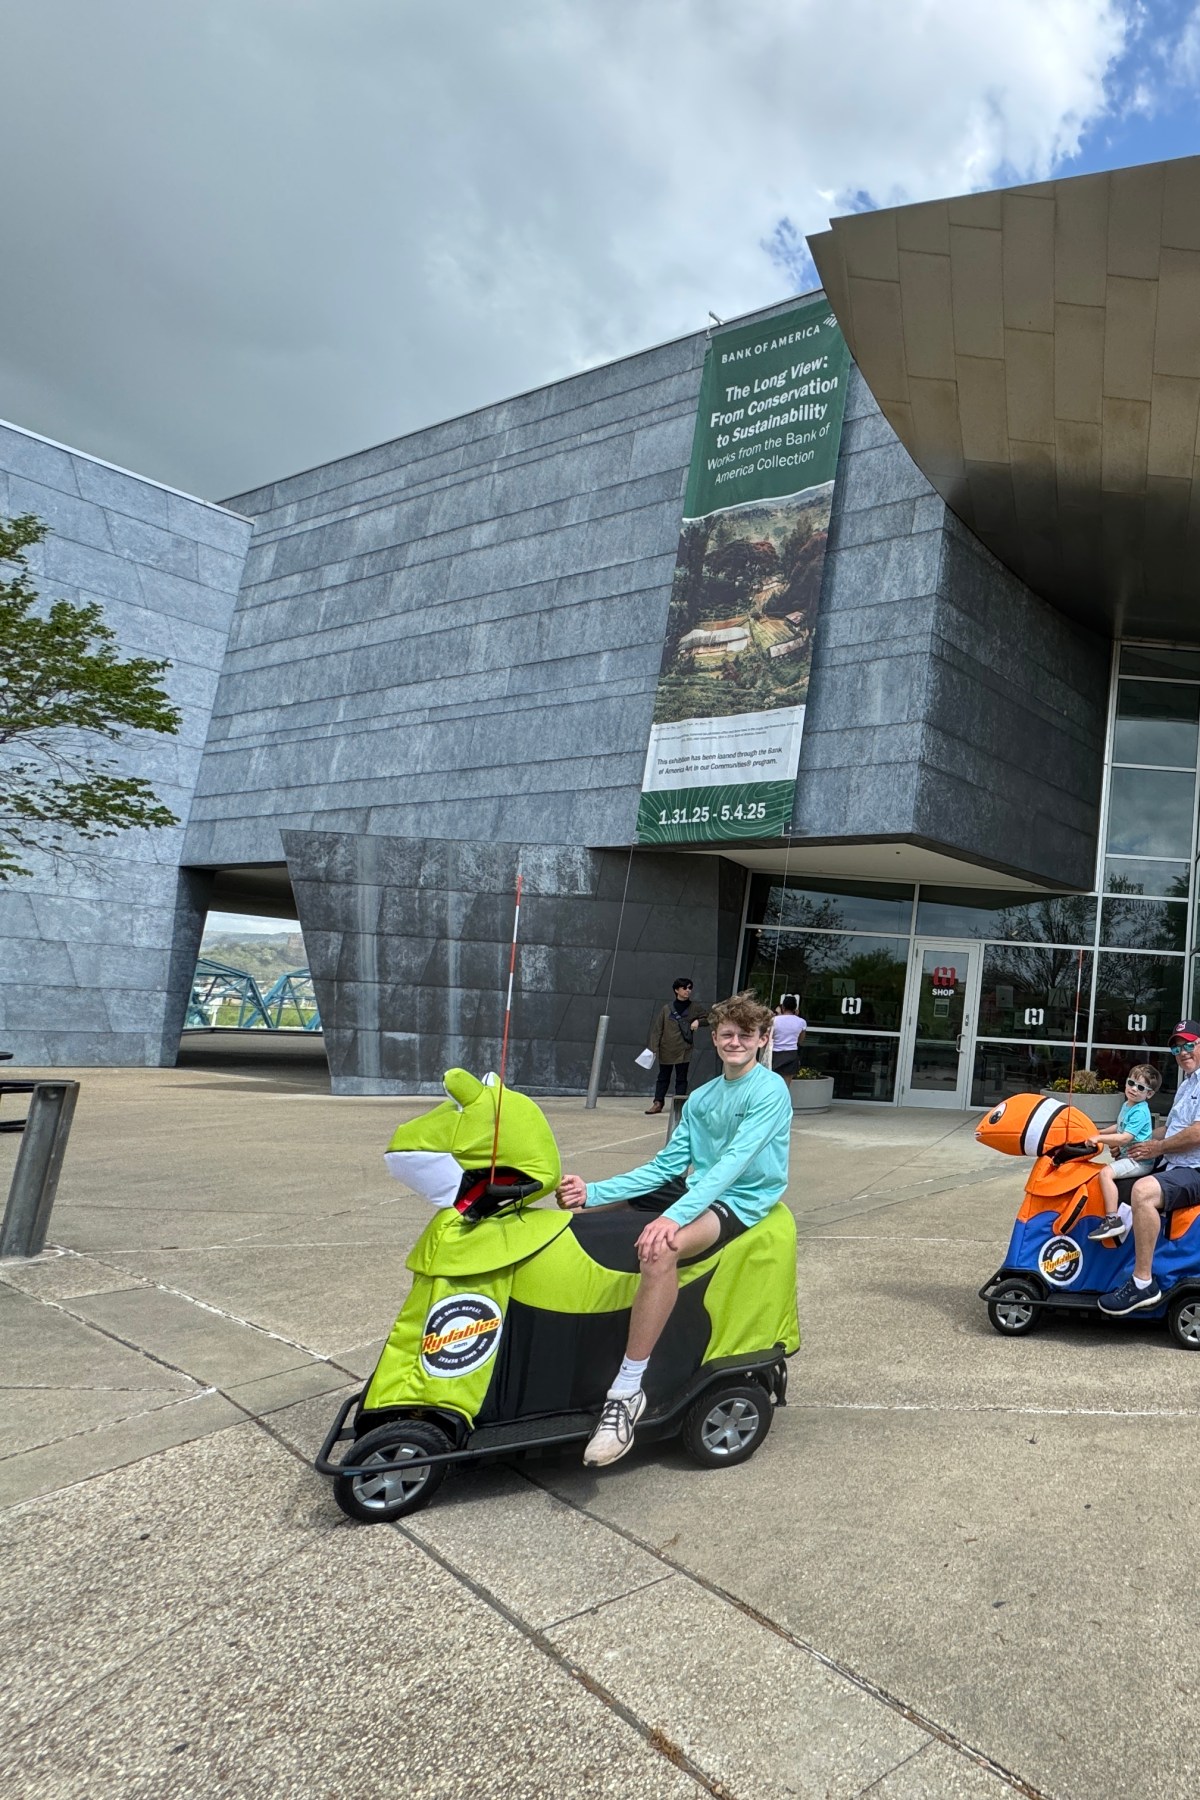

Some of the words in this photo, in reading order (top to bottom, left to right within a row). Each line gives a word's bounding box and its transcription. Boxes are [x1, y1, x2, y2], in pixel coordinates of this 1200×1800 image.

[721, 347, 752, 364] BANK
[754, 342, 769, 355] OF
[770, 324, 821, 350] AMERICA
[725, 385, 751, 402] The
[753, 370, 788, 394] Long
[791, 356, 828, 379] View:
[710, 408, 744, 428] From
[747, 376, 839, 416] Conservation
[707, 451, 736, 471] Works
[738, 443, 762, 459] from
[764, 437, 782, 451] the
[785, 429, 817, 446] Bank
[818, 421, 831, 438] of
[716, 433, 730, 449] to
[731, 403, 828, 442] Sustainability
[715, 463, 754, 485] America
[756, 449, 815, 471] Collection
[658, 806, 710, 825] 1.31.25
[720, 802, 766, 821] 5.4.25
[931, 988, 955, 997] SHOP
[422, 1317, 501, 1354] Rydables
